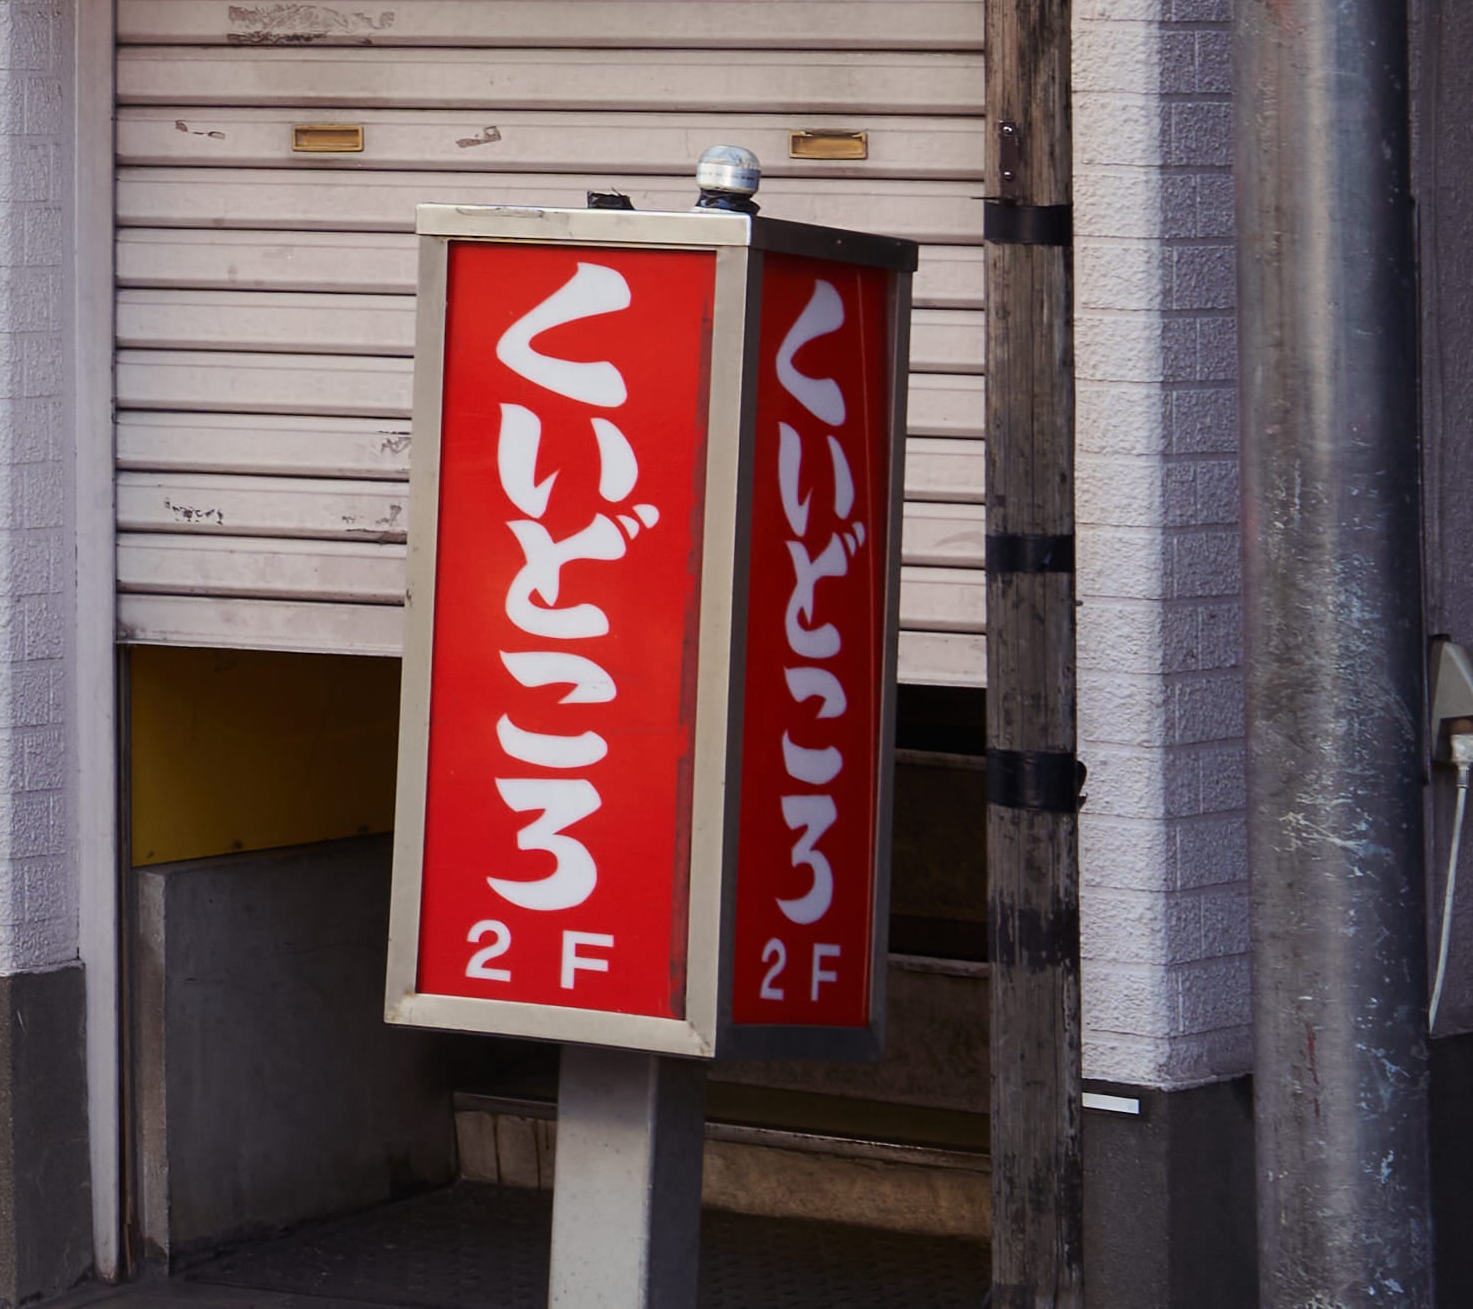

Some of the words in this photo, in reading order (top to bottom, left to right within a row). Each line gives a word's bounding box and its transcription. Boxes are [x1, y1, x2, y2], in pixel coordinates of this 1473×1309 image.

[486, 262, 660, 912] くいどころ
[773, 278, 867, 926] くいどころ
